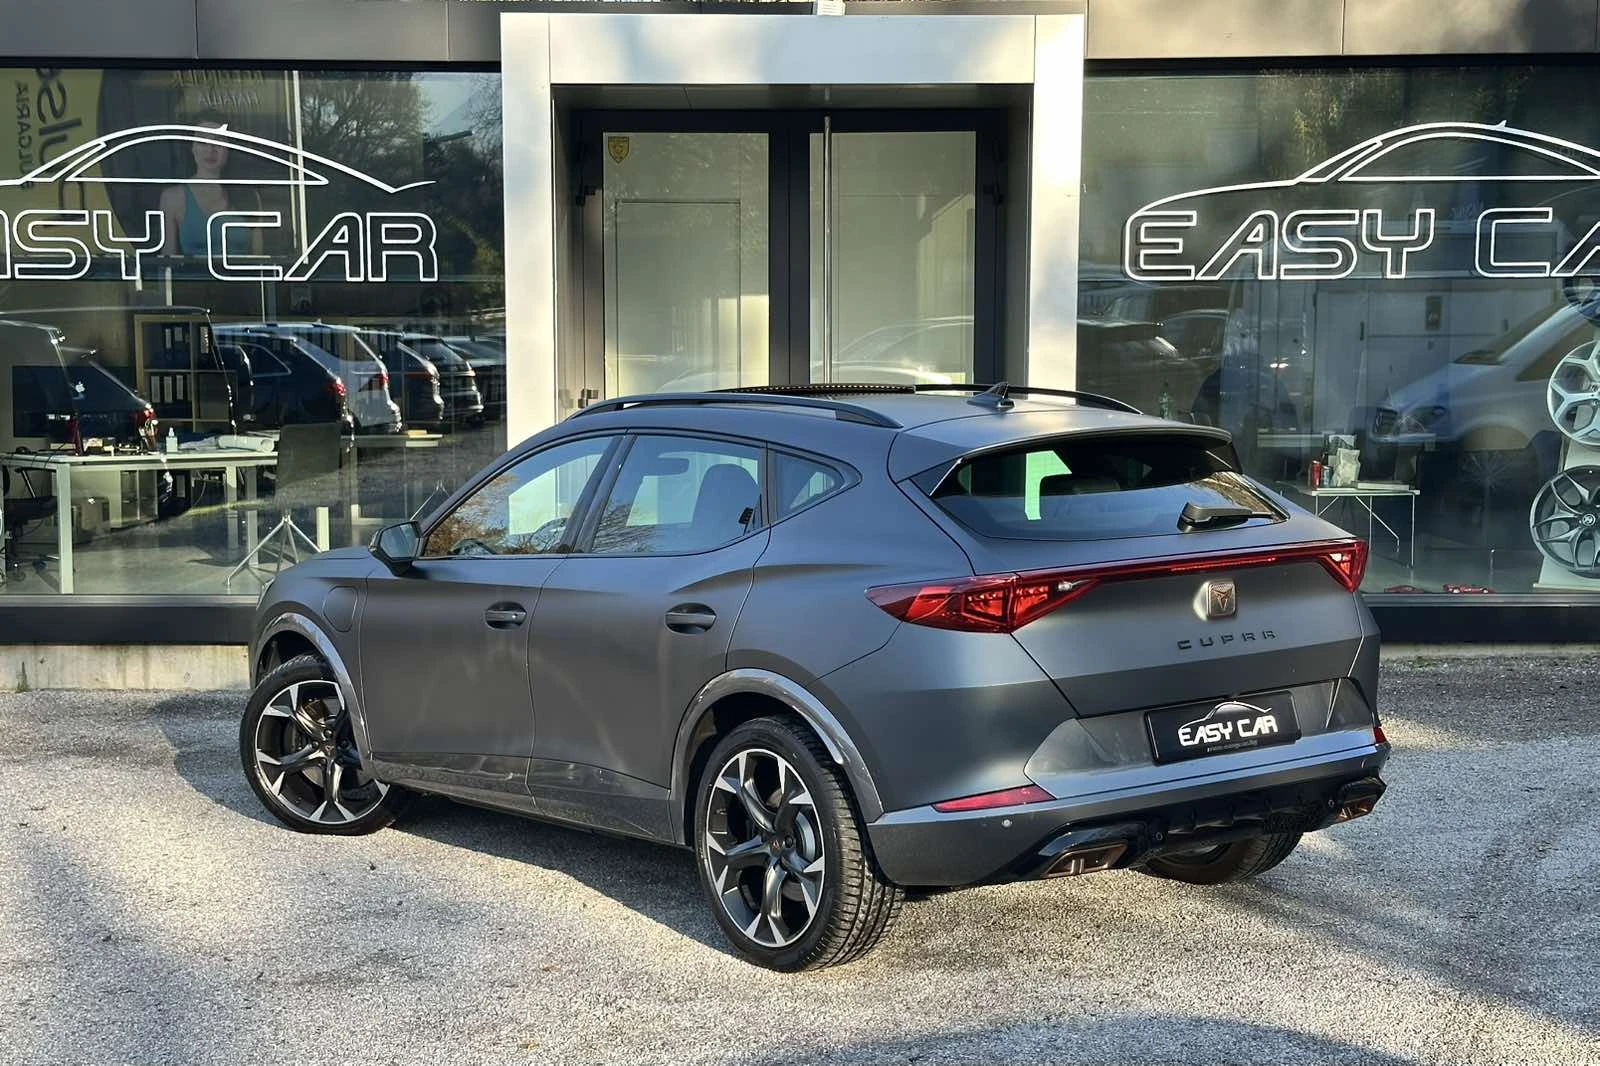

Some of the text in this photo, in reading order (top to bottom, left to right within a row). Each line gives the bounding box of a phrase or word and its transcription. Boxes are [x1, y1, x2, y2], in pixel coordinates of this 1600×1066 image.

[0, 209, 439, 282] SY CAR
[1124, 208, 1436, 281] EASY
[1178, 630, 1276, 650] CUPRA
[1178, 715, 1278, 746] EASY CAR
